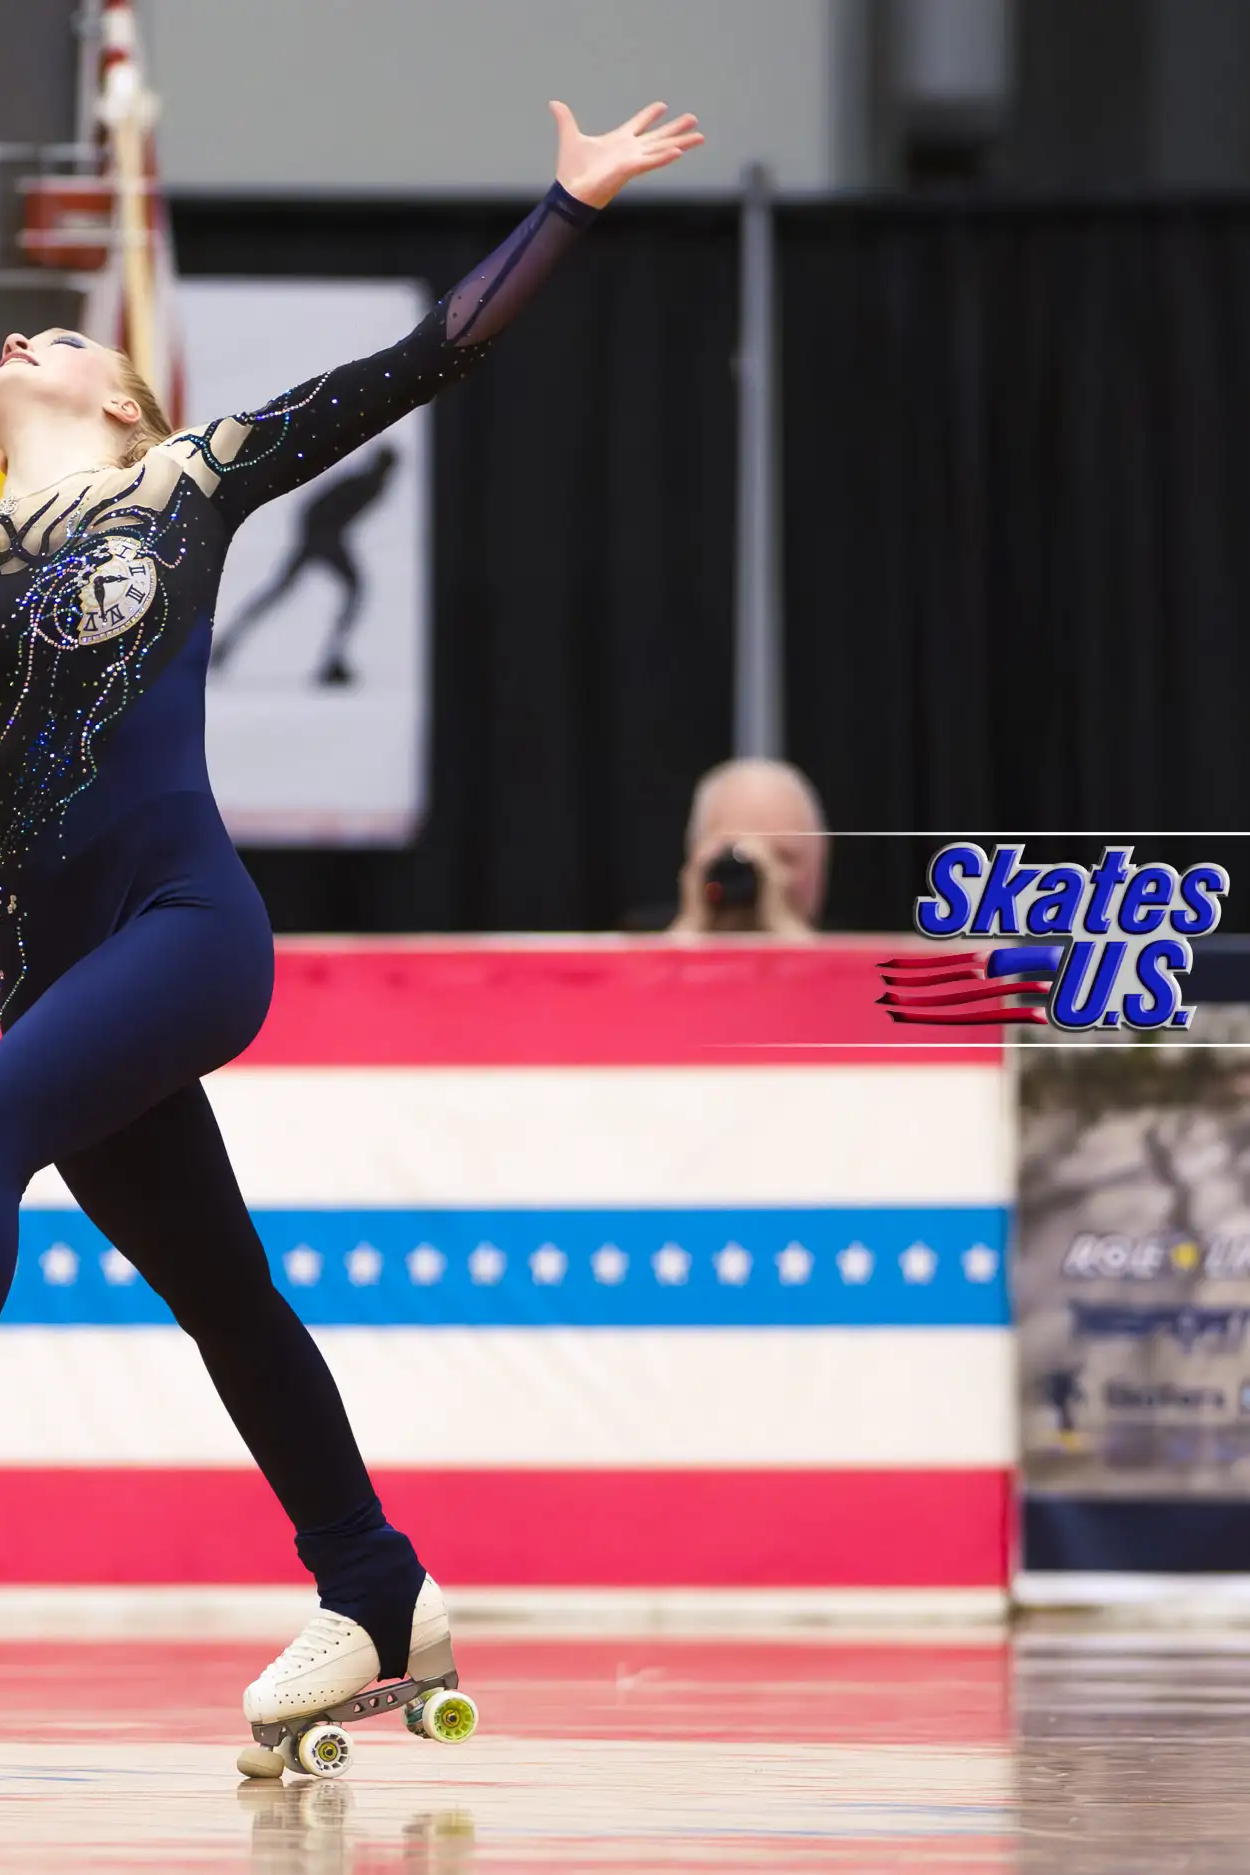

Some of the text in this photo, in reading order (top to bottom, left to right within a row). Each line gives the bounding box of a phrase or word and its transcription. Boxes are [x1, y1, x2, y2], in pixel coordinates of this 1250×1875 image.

[116, 545, 132, 559] I
[129, 565, 146, 577] II
[126, 585, 146, 604] III
[83, 612, 98, 631] V
